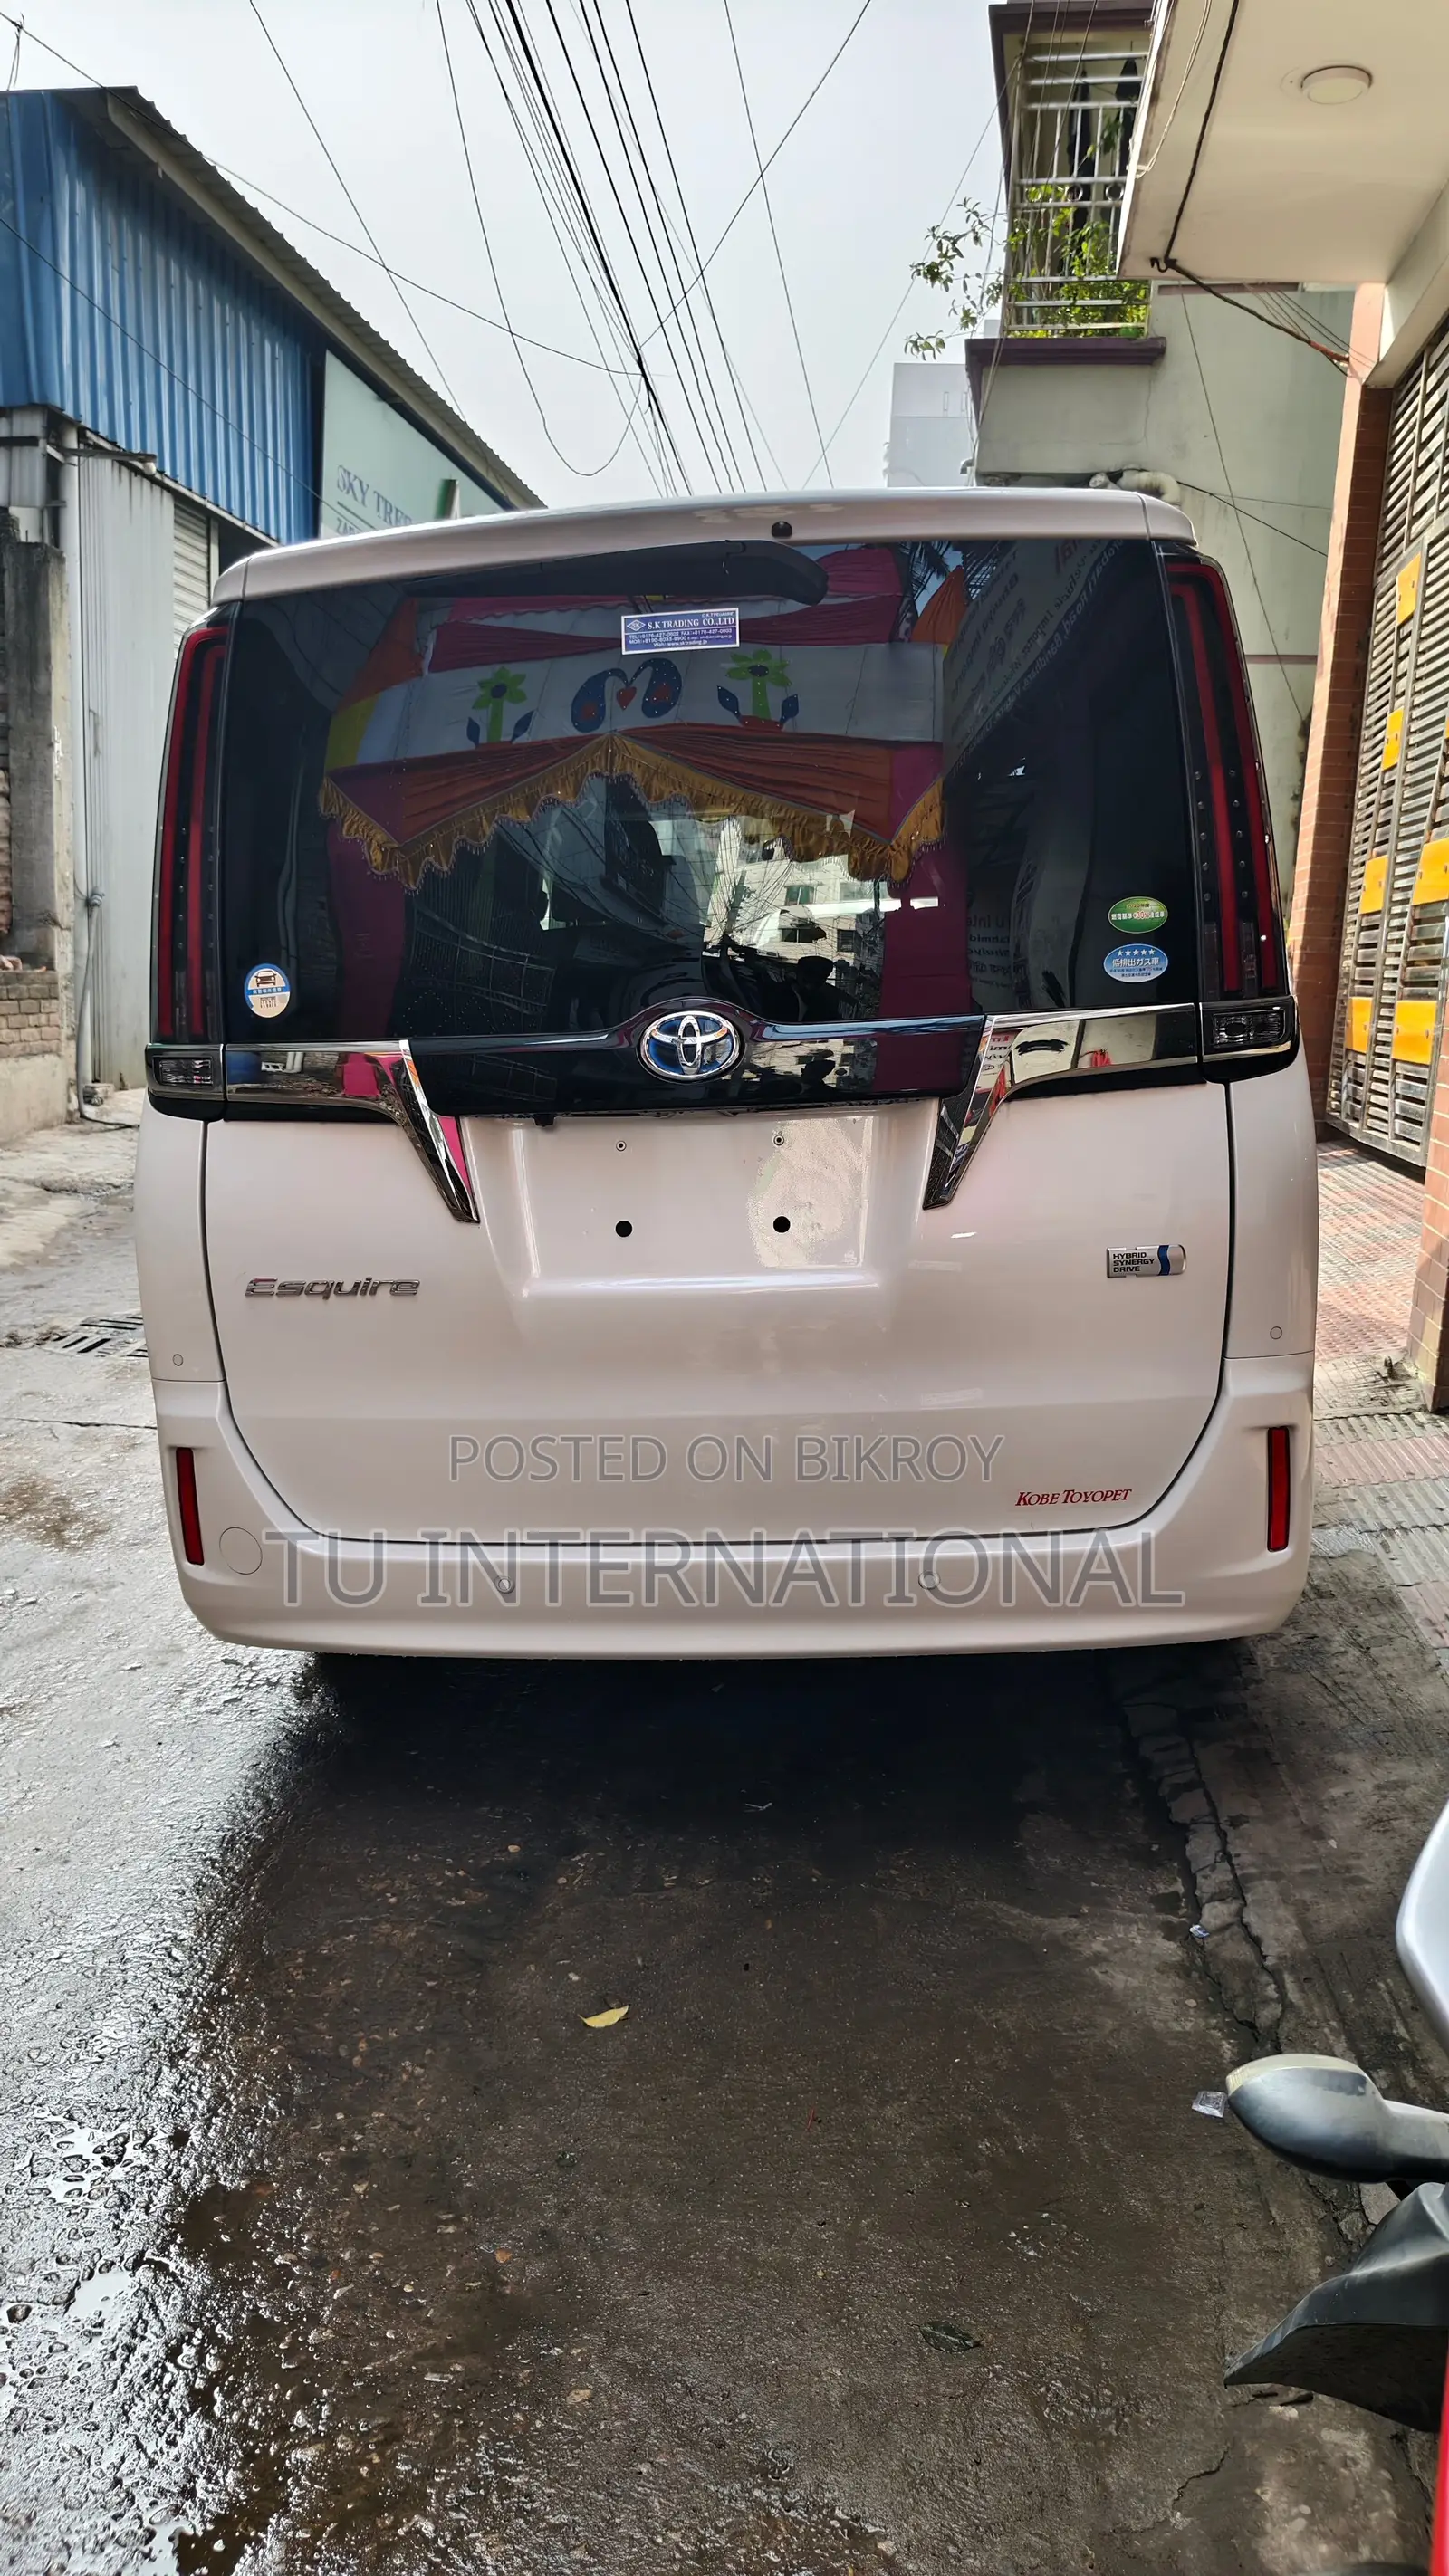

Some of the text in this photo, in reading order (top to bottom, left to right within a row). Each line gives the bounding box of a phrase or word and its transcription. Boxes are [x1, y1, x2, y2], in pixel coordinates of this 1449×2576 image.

[337, 464, 369, 508] SKY
[648, 621, 661, 629] S.K
[662, 618, 699, 628] TRADING
[1112, 957, 1159, 968] 低排出ガス車
[1113, 1251, 1147, 1259] HYBRID
[1113, 1258, 1156, 1267] SYNERGY
[1113, 1265, 1141, 1273] DRIVE
[245, 1276, 420, 1300] Esquire
[1015, 1489, 1132, 1506] KOBE TOYOPET
